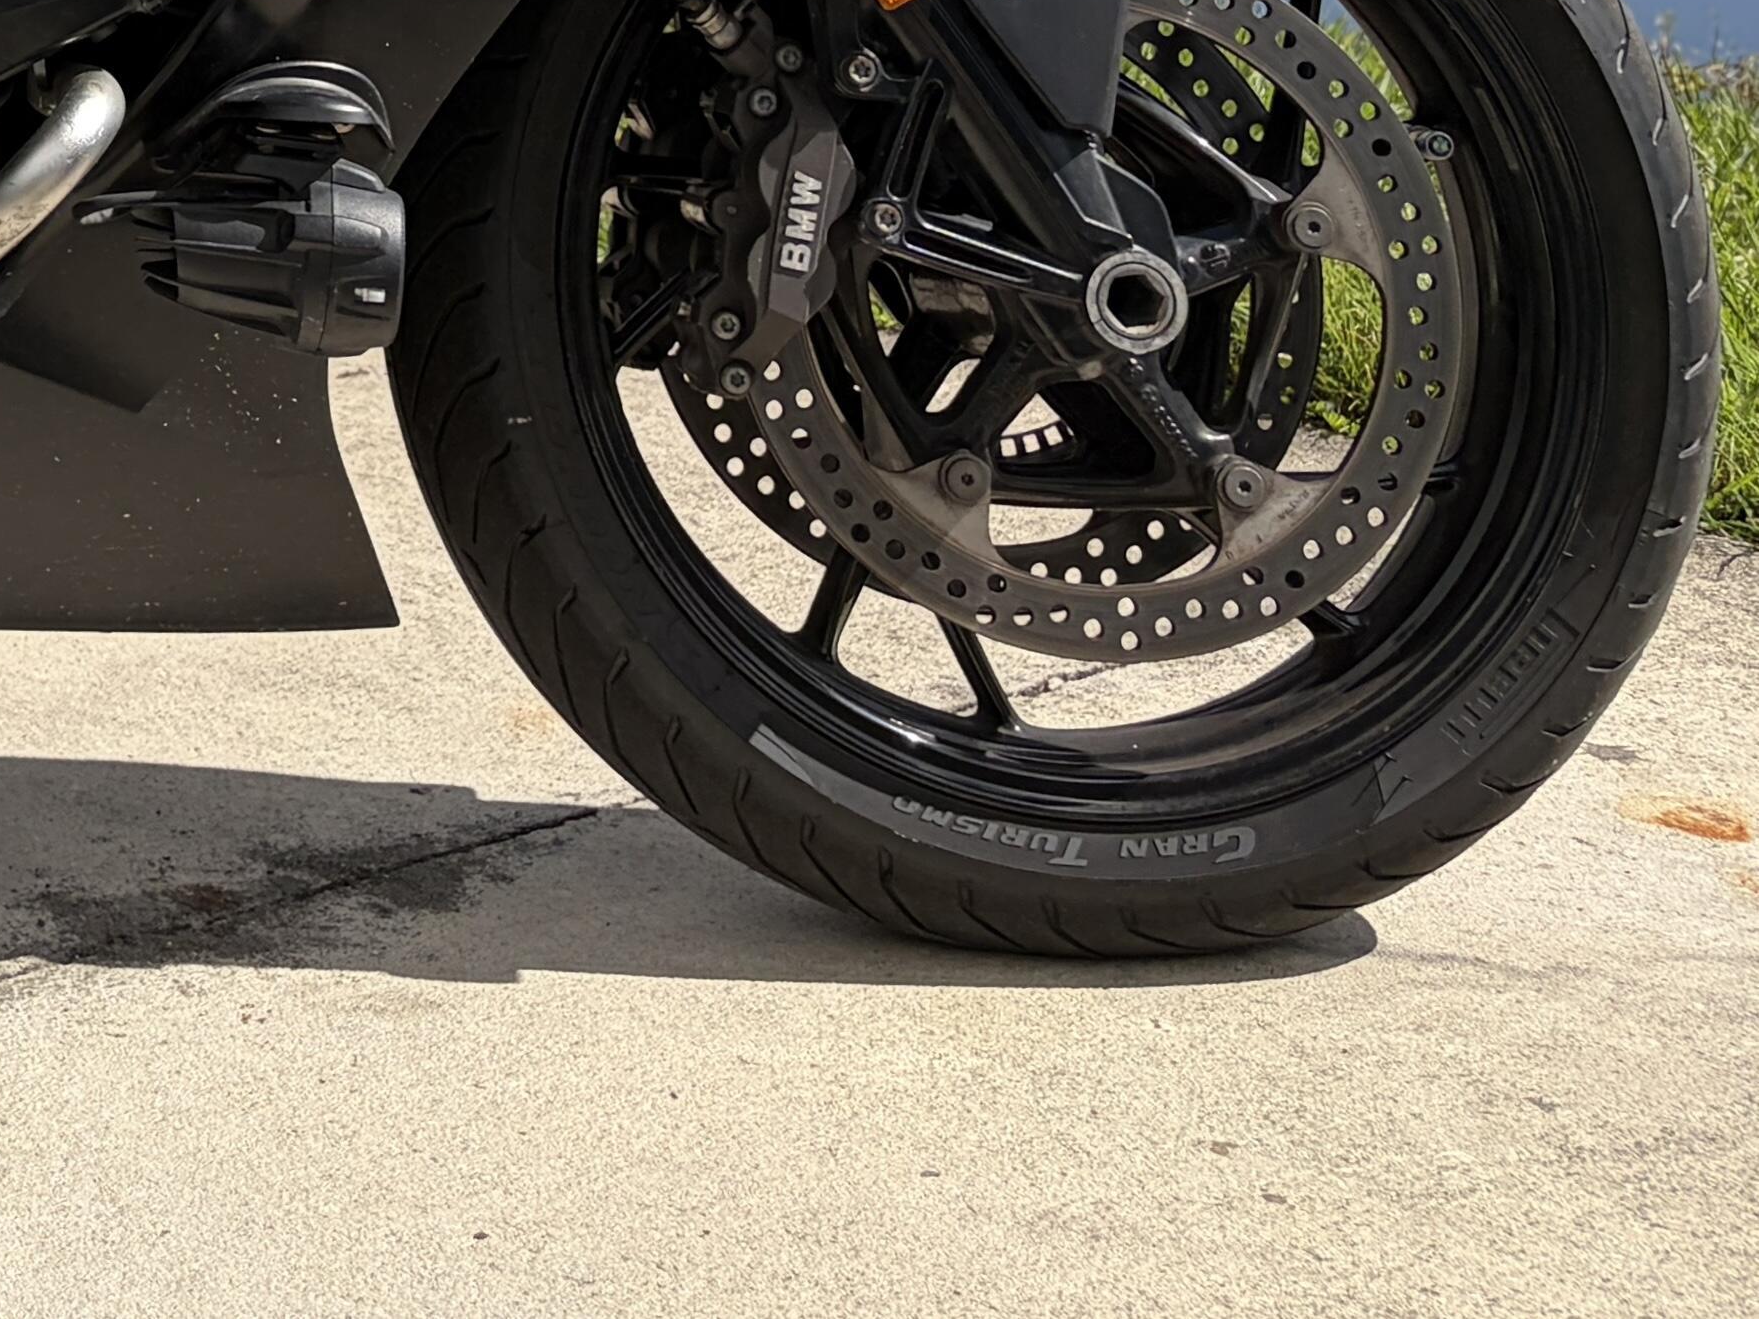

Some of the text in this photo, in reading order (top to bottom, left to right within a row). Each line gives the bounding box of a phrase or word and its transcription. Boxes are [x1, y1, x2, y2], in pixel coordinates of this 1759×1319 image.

[780, 170, 823, 272] BMW
[892, 796, 1256, 868] GRAN TURISMO
